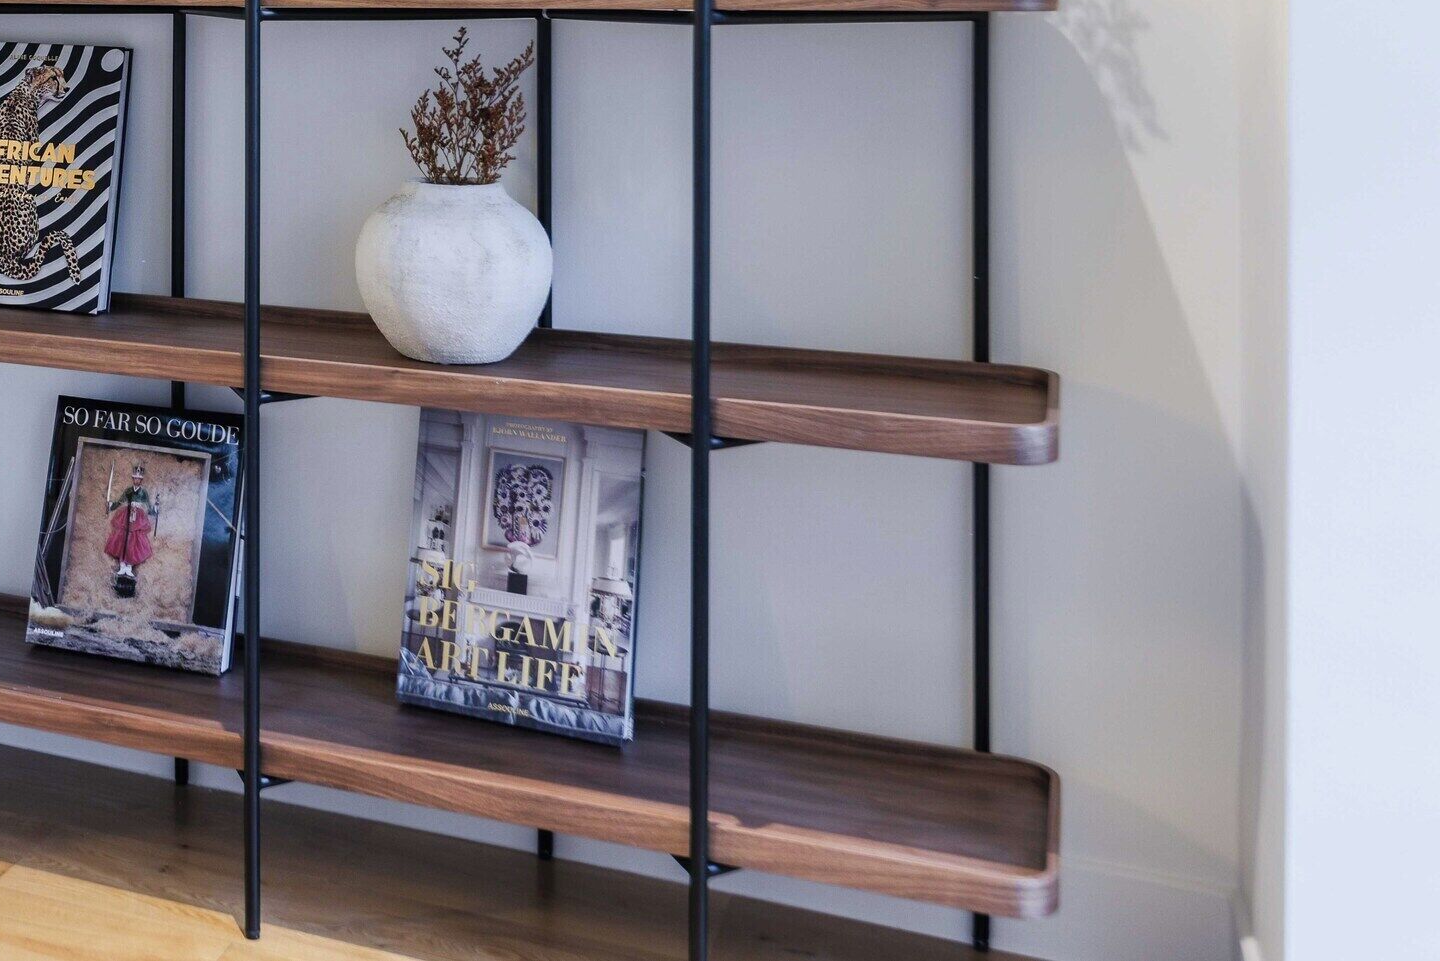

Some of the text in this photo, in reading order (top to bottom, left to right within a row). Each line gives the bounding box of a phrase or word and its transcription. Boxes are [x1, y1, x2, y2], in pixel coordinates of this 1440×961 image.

[63, 405, 241, 446] SO FAR SO GOUDE
[420, 558, 478, 592] SIG
[418, 594, 617, 659] BERGAMIN
[415, 636, 587, 697] ART LIFE
